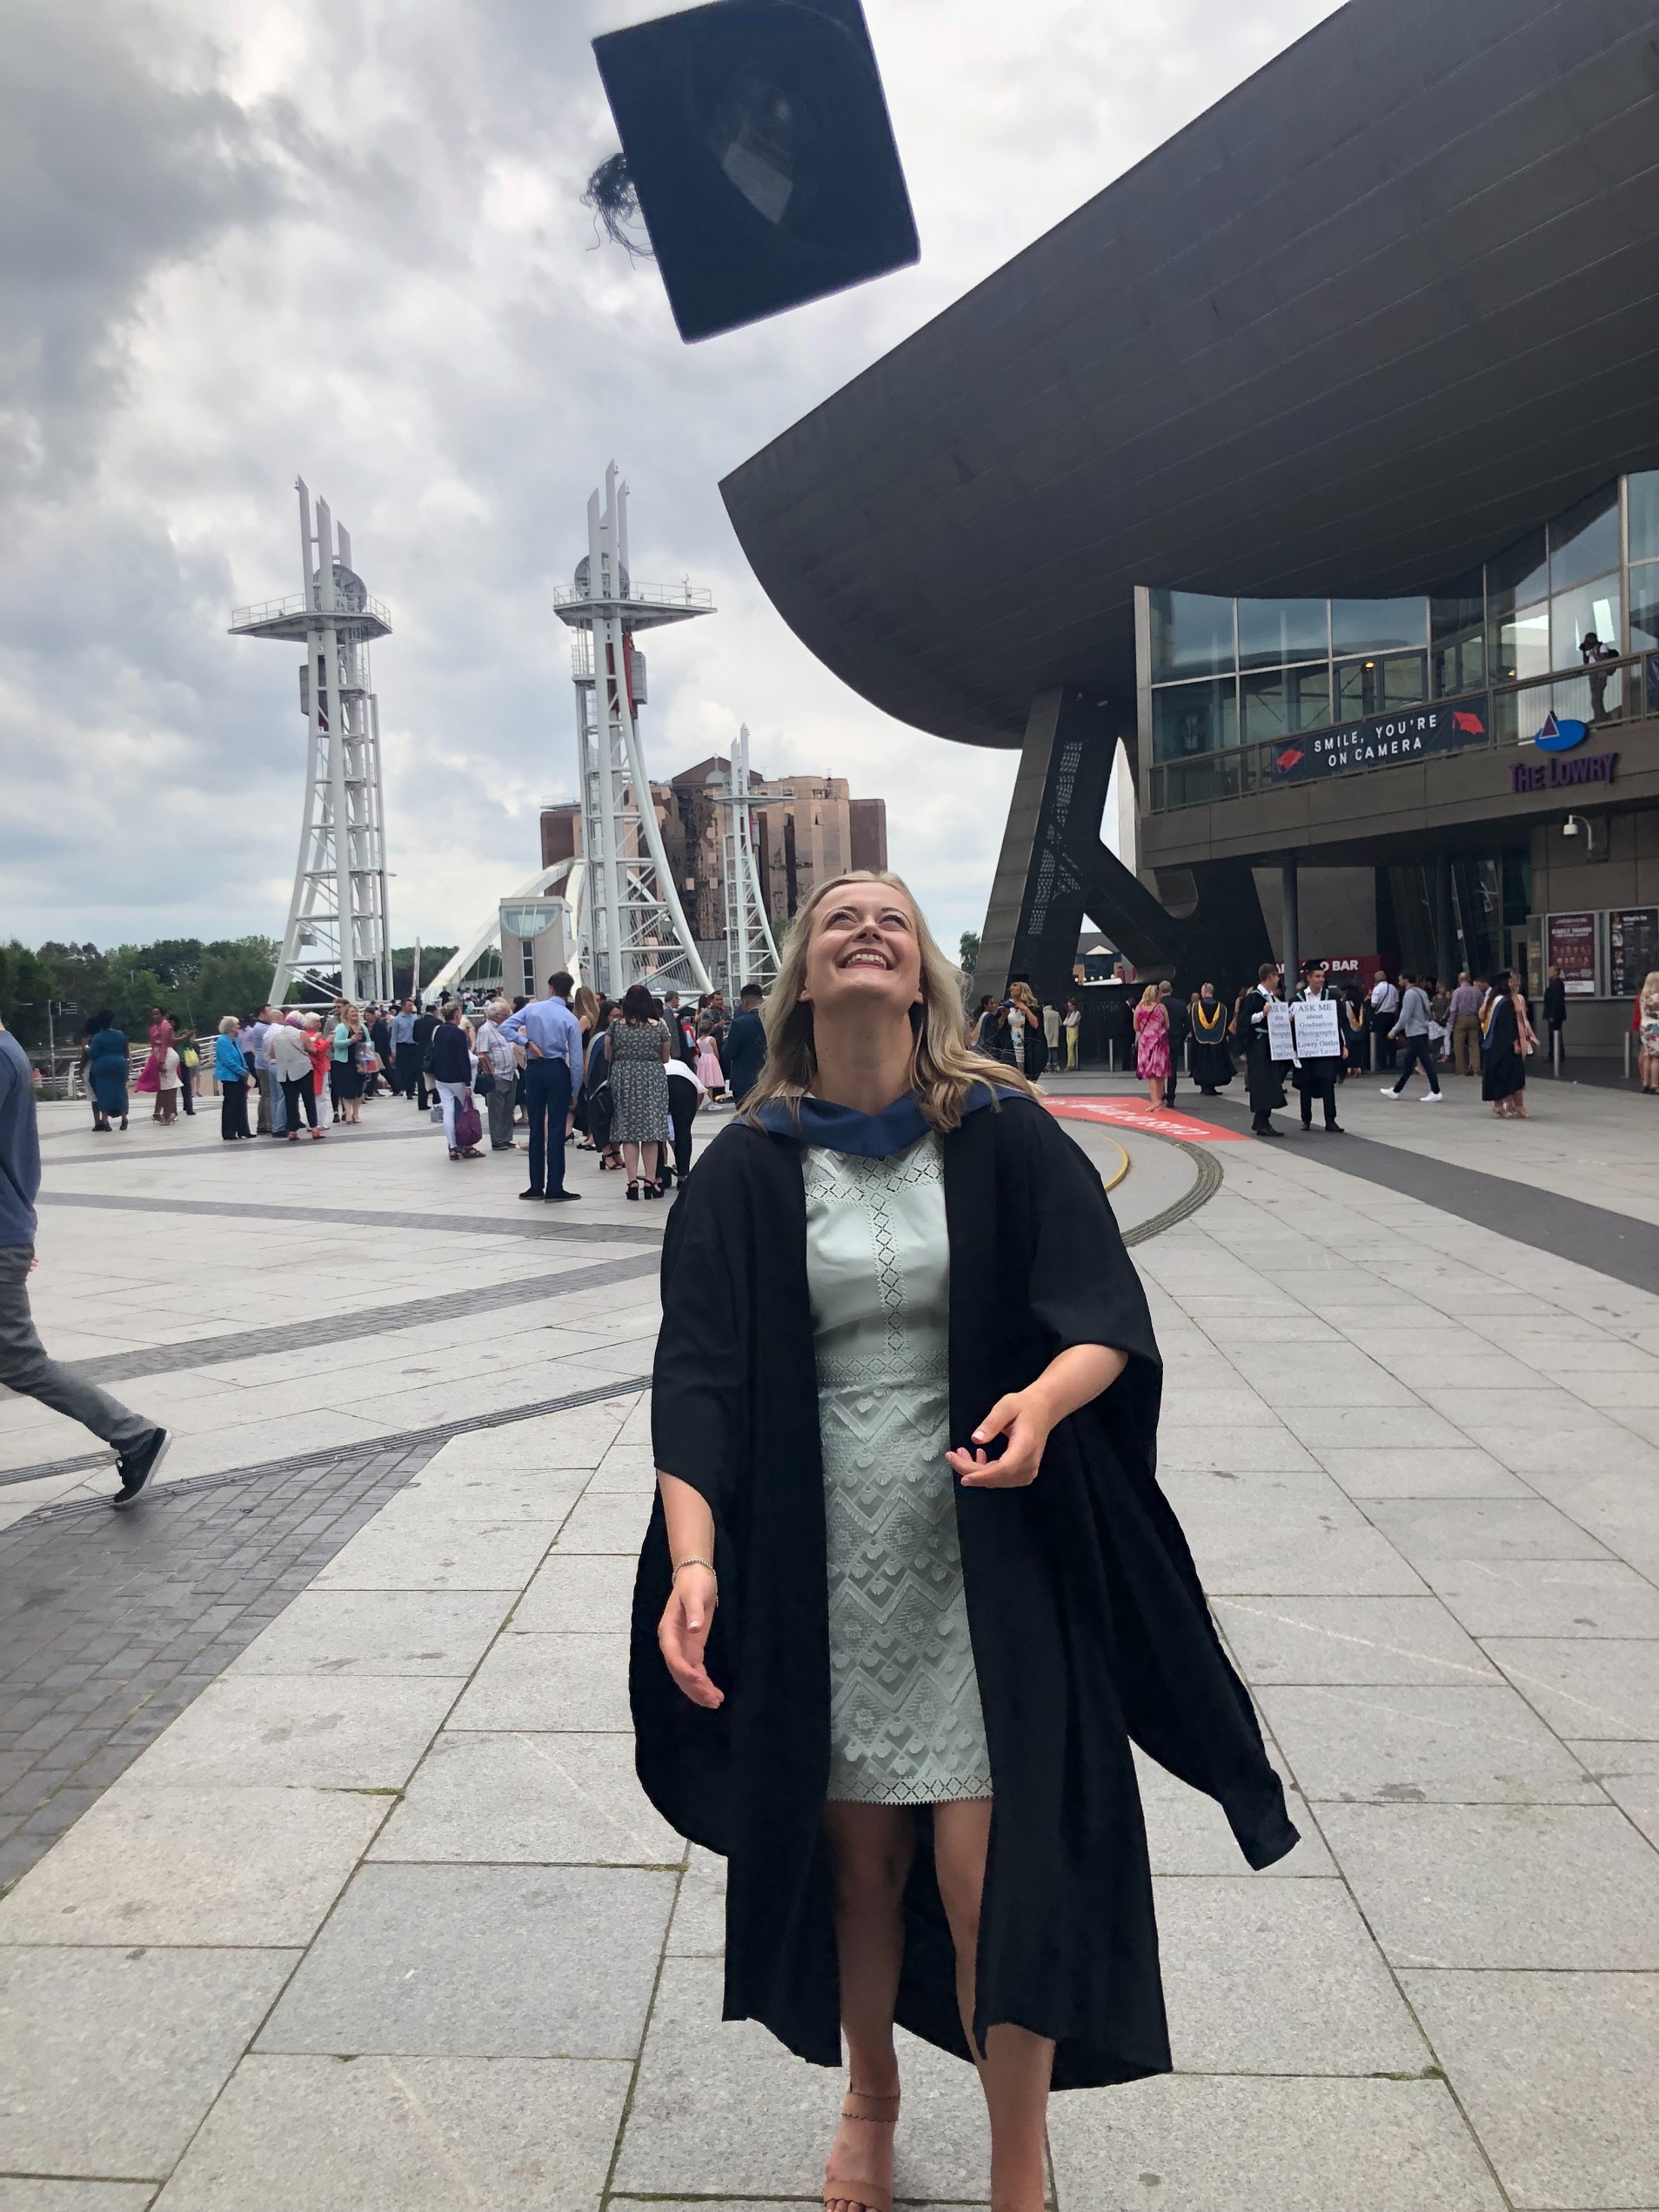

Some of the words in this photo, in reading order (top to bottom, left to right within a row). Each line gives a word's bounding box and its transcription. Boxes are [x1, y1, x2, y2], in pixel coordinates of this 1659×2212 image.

[1314, 732, 1364, 752] SMILE,
[1375, 714, 1436, 738] YOU'RE
[1328, 752, 1348, 767] ON
[1355, 737, 1422, 761] CAMERA
[1509, 764, 1546, 792] THE
[1548, 752, 1617, 787] LOWRY
[1332, 959, 1359, 972] BAR
[1298, 1005, 1315, 1013] ASK
[1298, 1029, 1335, 1038] Photography
